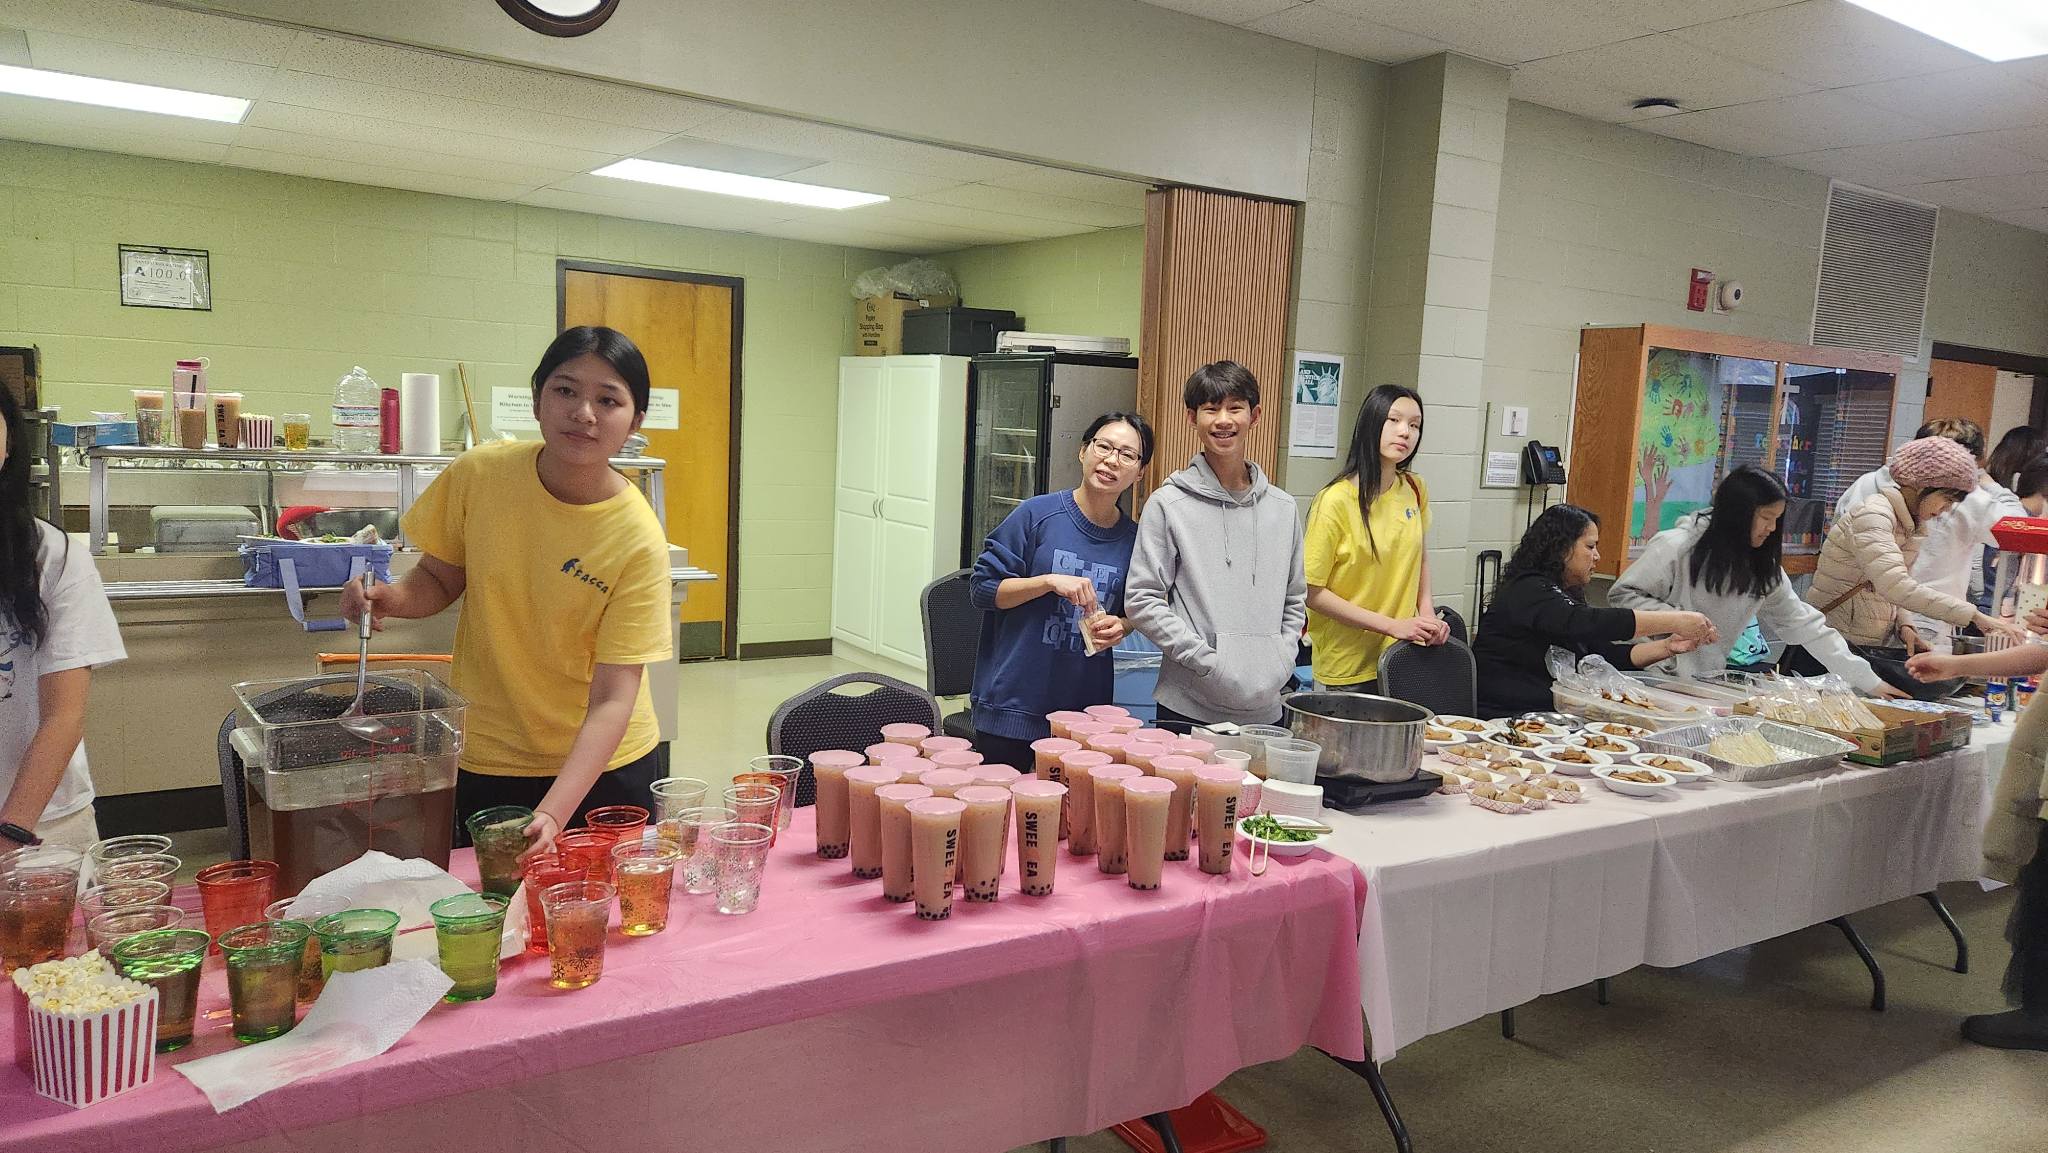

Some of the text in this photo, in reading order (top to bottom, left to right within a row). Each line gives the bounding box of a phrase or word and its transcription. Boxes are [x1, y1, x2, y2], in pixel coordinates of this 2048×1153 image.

[1025, 812, 1038, 877] SWEE EA
[1222, 796, 1237, 858] SWEE EA
[943, 829, 957, 900] SWEE EA
